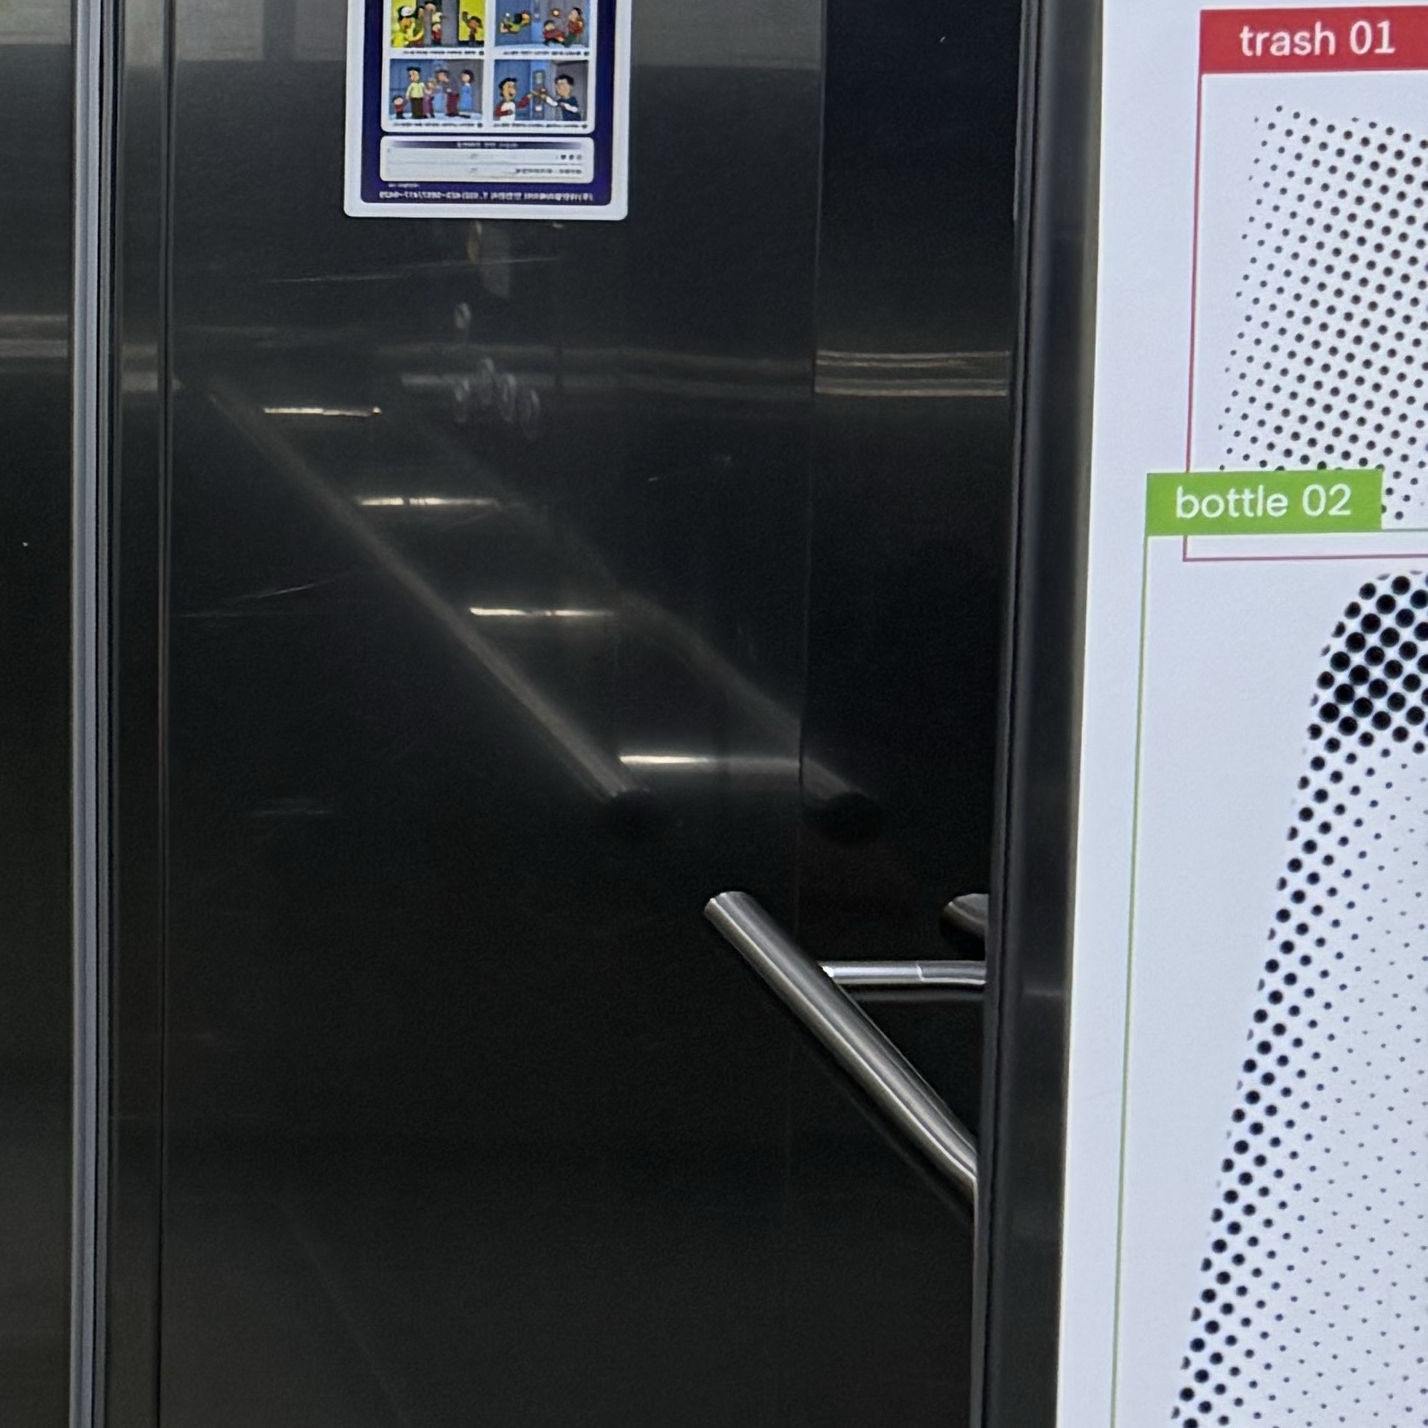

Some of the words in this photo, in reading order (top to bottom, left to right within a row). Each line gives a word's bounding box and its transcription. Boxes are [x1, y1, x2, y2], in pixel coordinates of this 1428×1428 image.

[1239, 21, 1336, 57] trash
[1349, 19, 1396, 55] 01
[1176, 484, 1288, 519] bottle
[1302, 483, 1351, 517] 02
